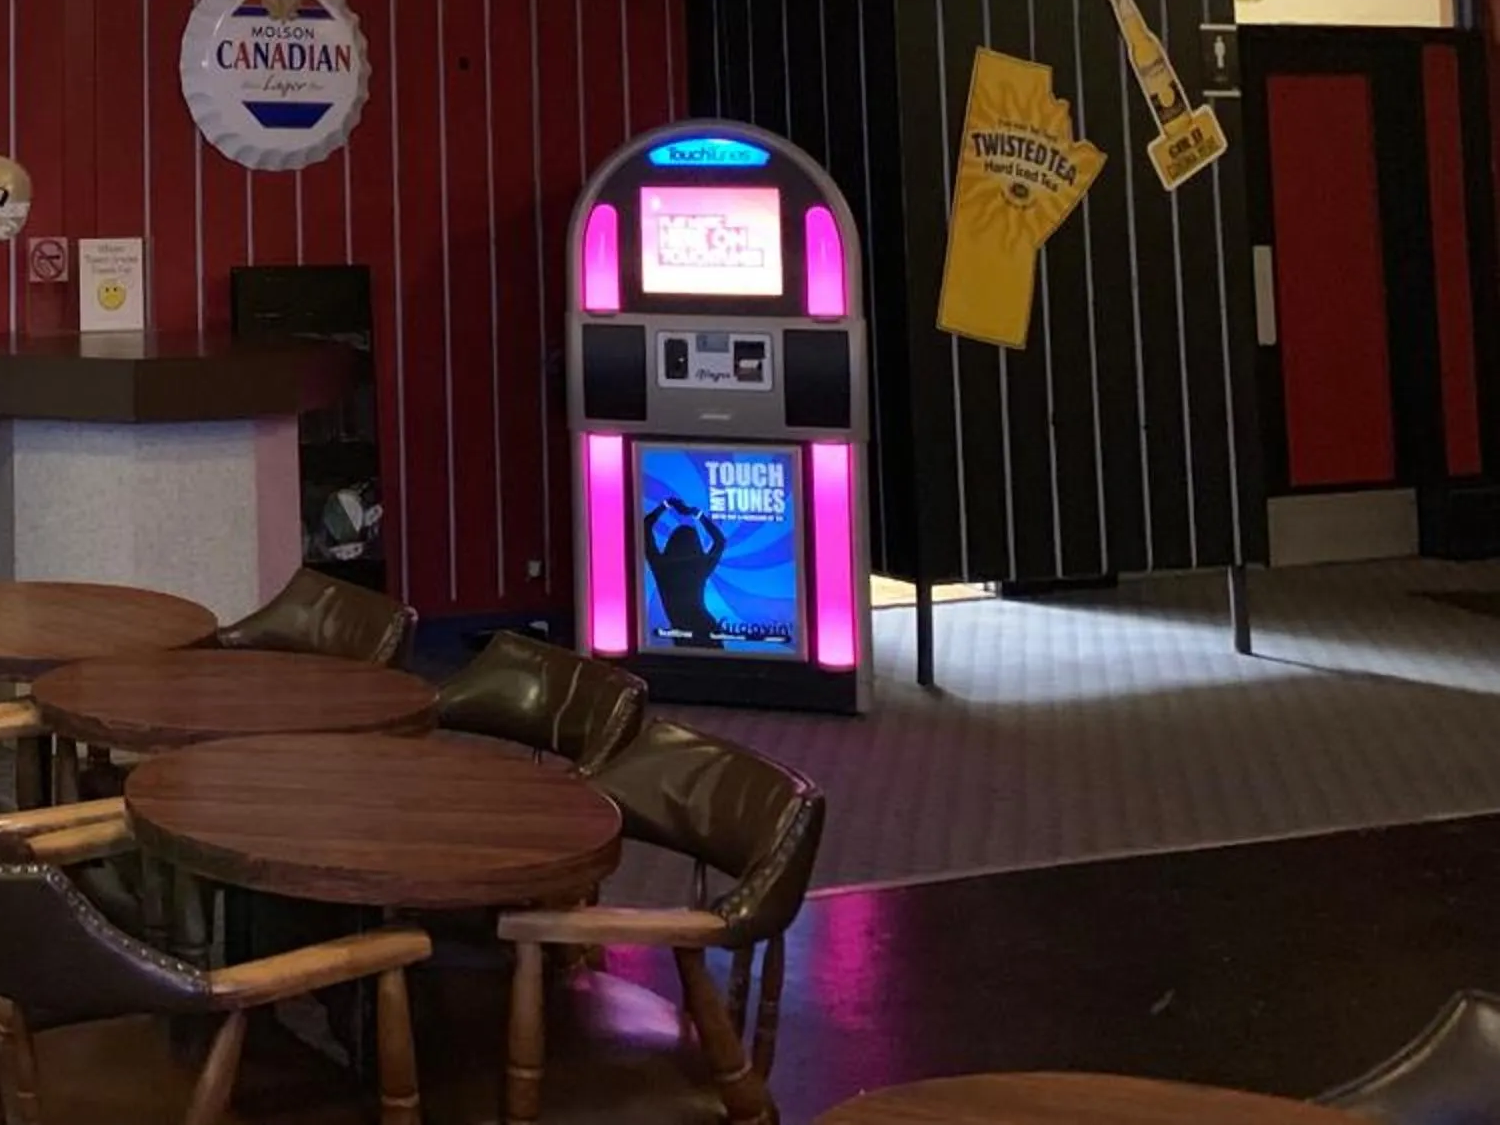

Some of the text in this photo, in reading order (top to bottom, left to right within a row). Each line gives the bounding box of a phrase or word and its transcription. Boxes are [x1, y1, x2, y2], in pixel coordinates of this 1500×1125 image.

[252, 26, 314, 40] MOLSON
[216, 40, 351, 72] CANADIAN
[972, 132, 1078, 187] TWISTED TEA
[705, 461, 785, 488] TOUCH
[710, 488, 786, 514] MY TUNES
